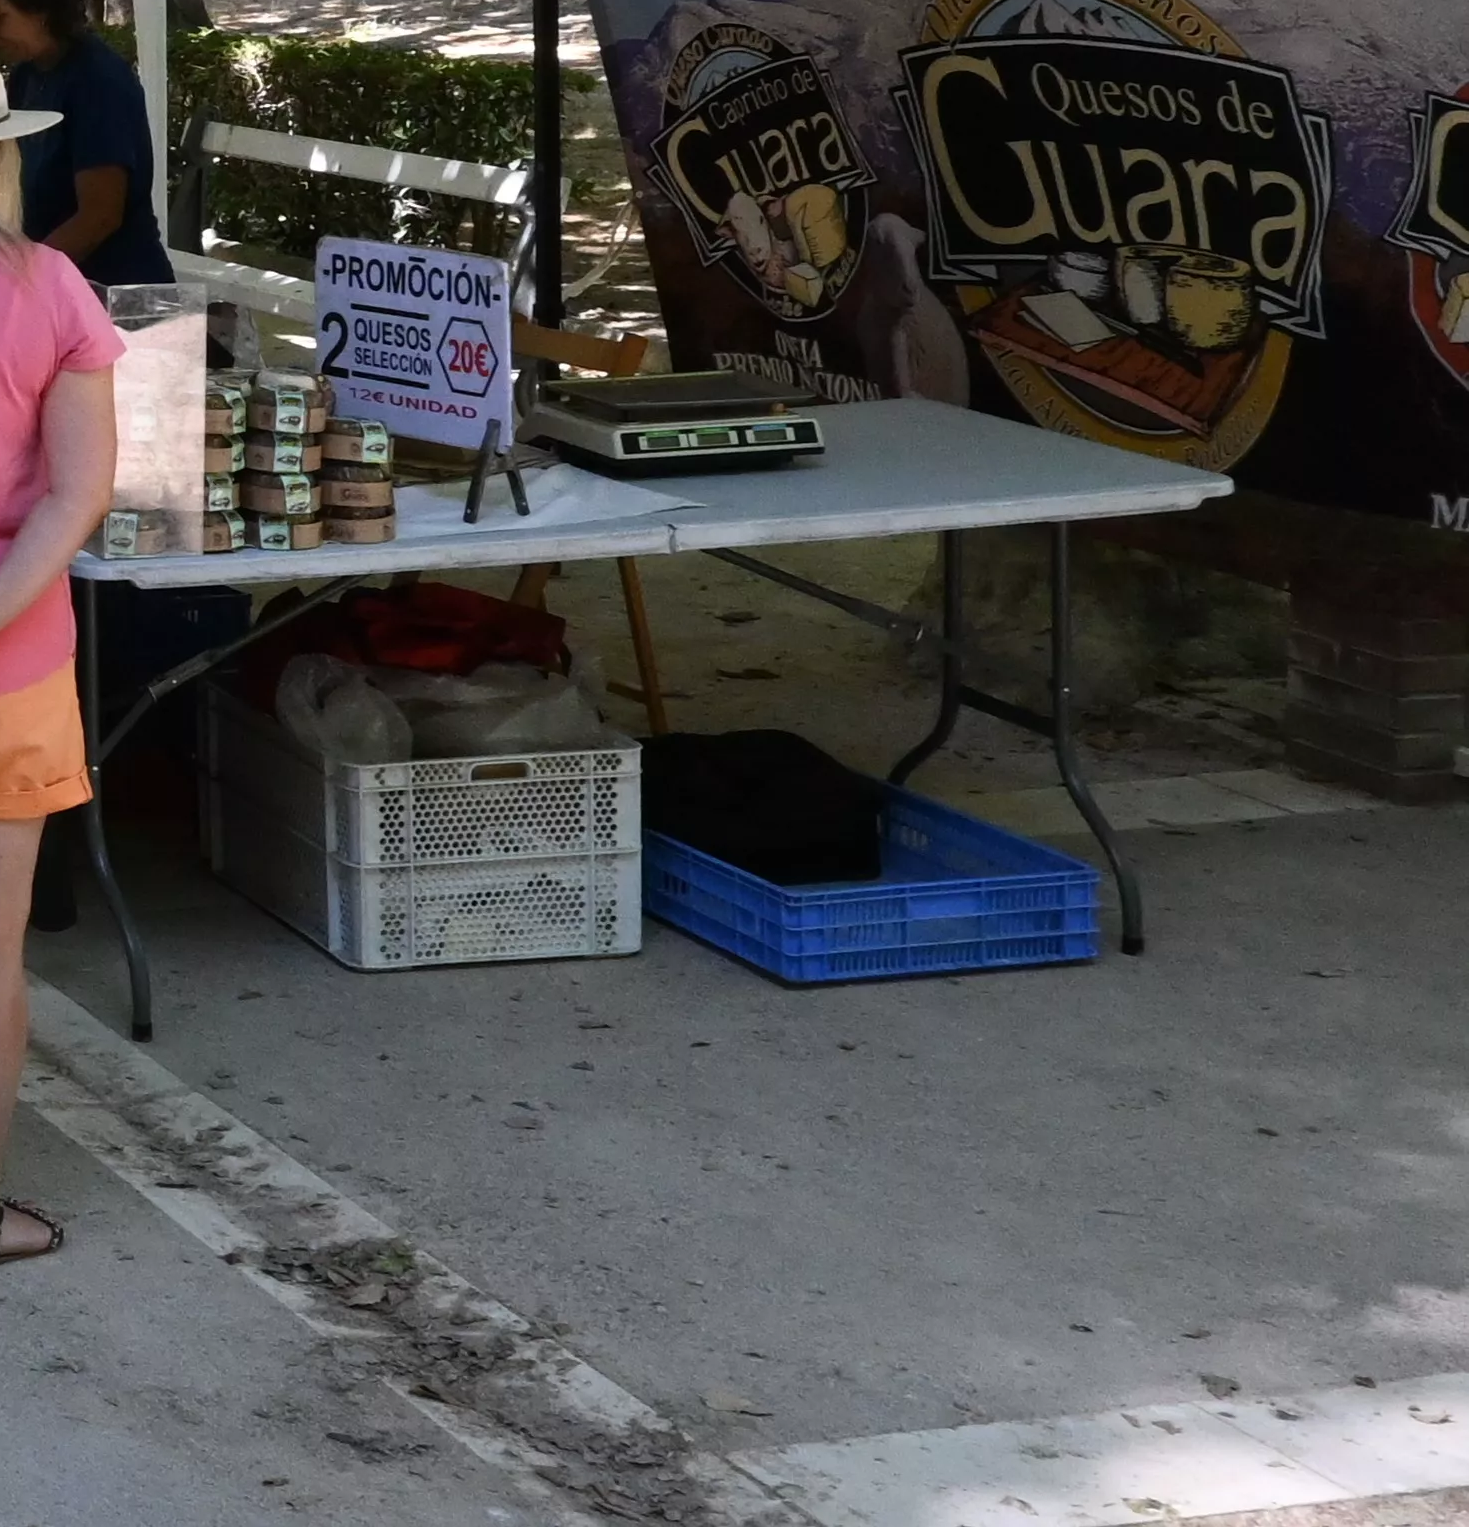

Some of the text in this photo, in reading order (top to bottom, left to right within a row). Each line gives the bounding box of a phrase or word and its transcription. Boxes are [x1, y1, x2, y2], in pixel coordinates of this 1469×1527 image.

[665, 24, 774, 112] Queso Curado
[707, 66, 818, 130] Capricho de
[1030, 61, 1277, 140] Quesos de
[666, 111, 853, 224] Guara
[921, 54, 1308, 288] Guara
[321, 311, 350, 380] 2
[353, 317, 432, 353] QUESOS
[354, 346, 433, 377] SELECCIÓN
[447, 338, 491, 378] 20€
[712, 352, 794, 386] PREMIO
[348, 386, 478, 420] 12€ UNIDAD
